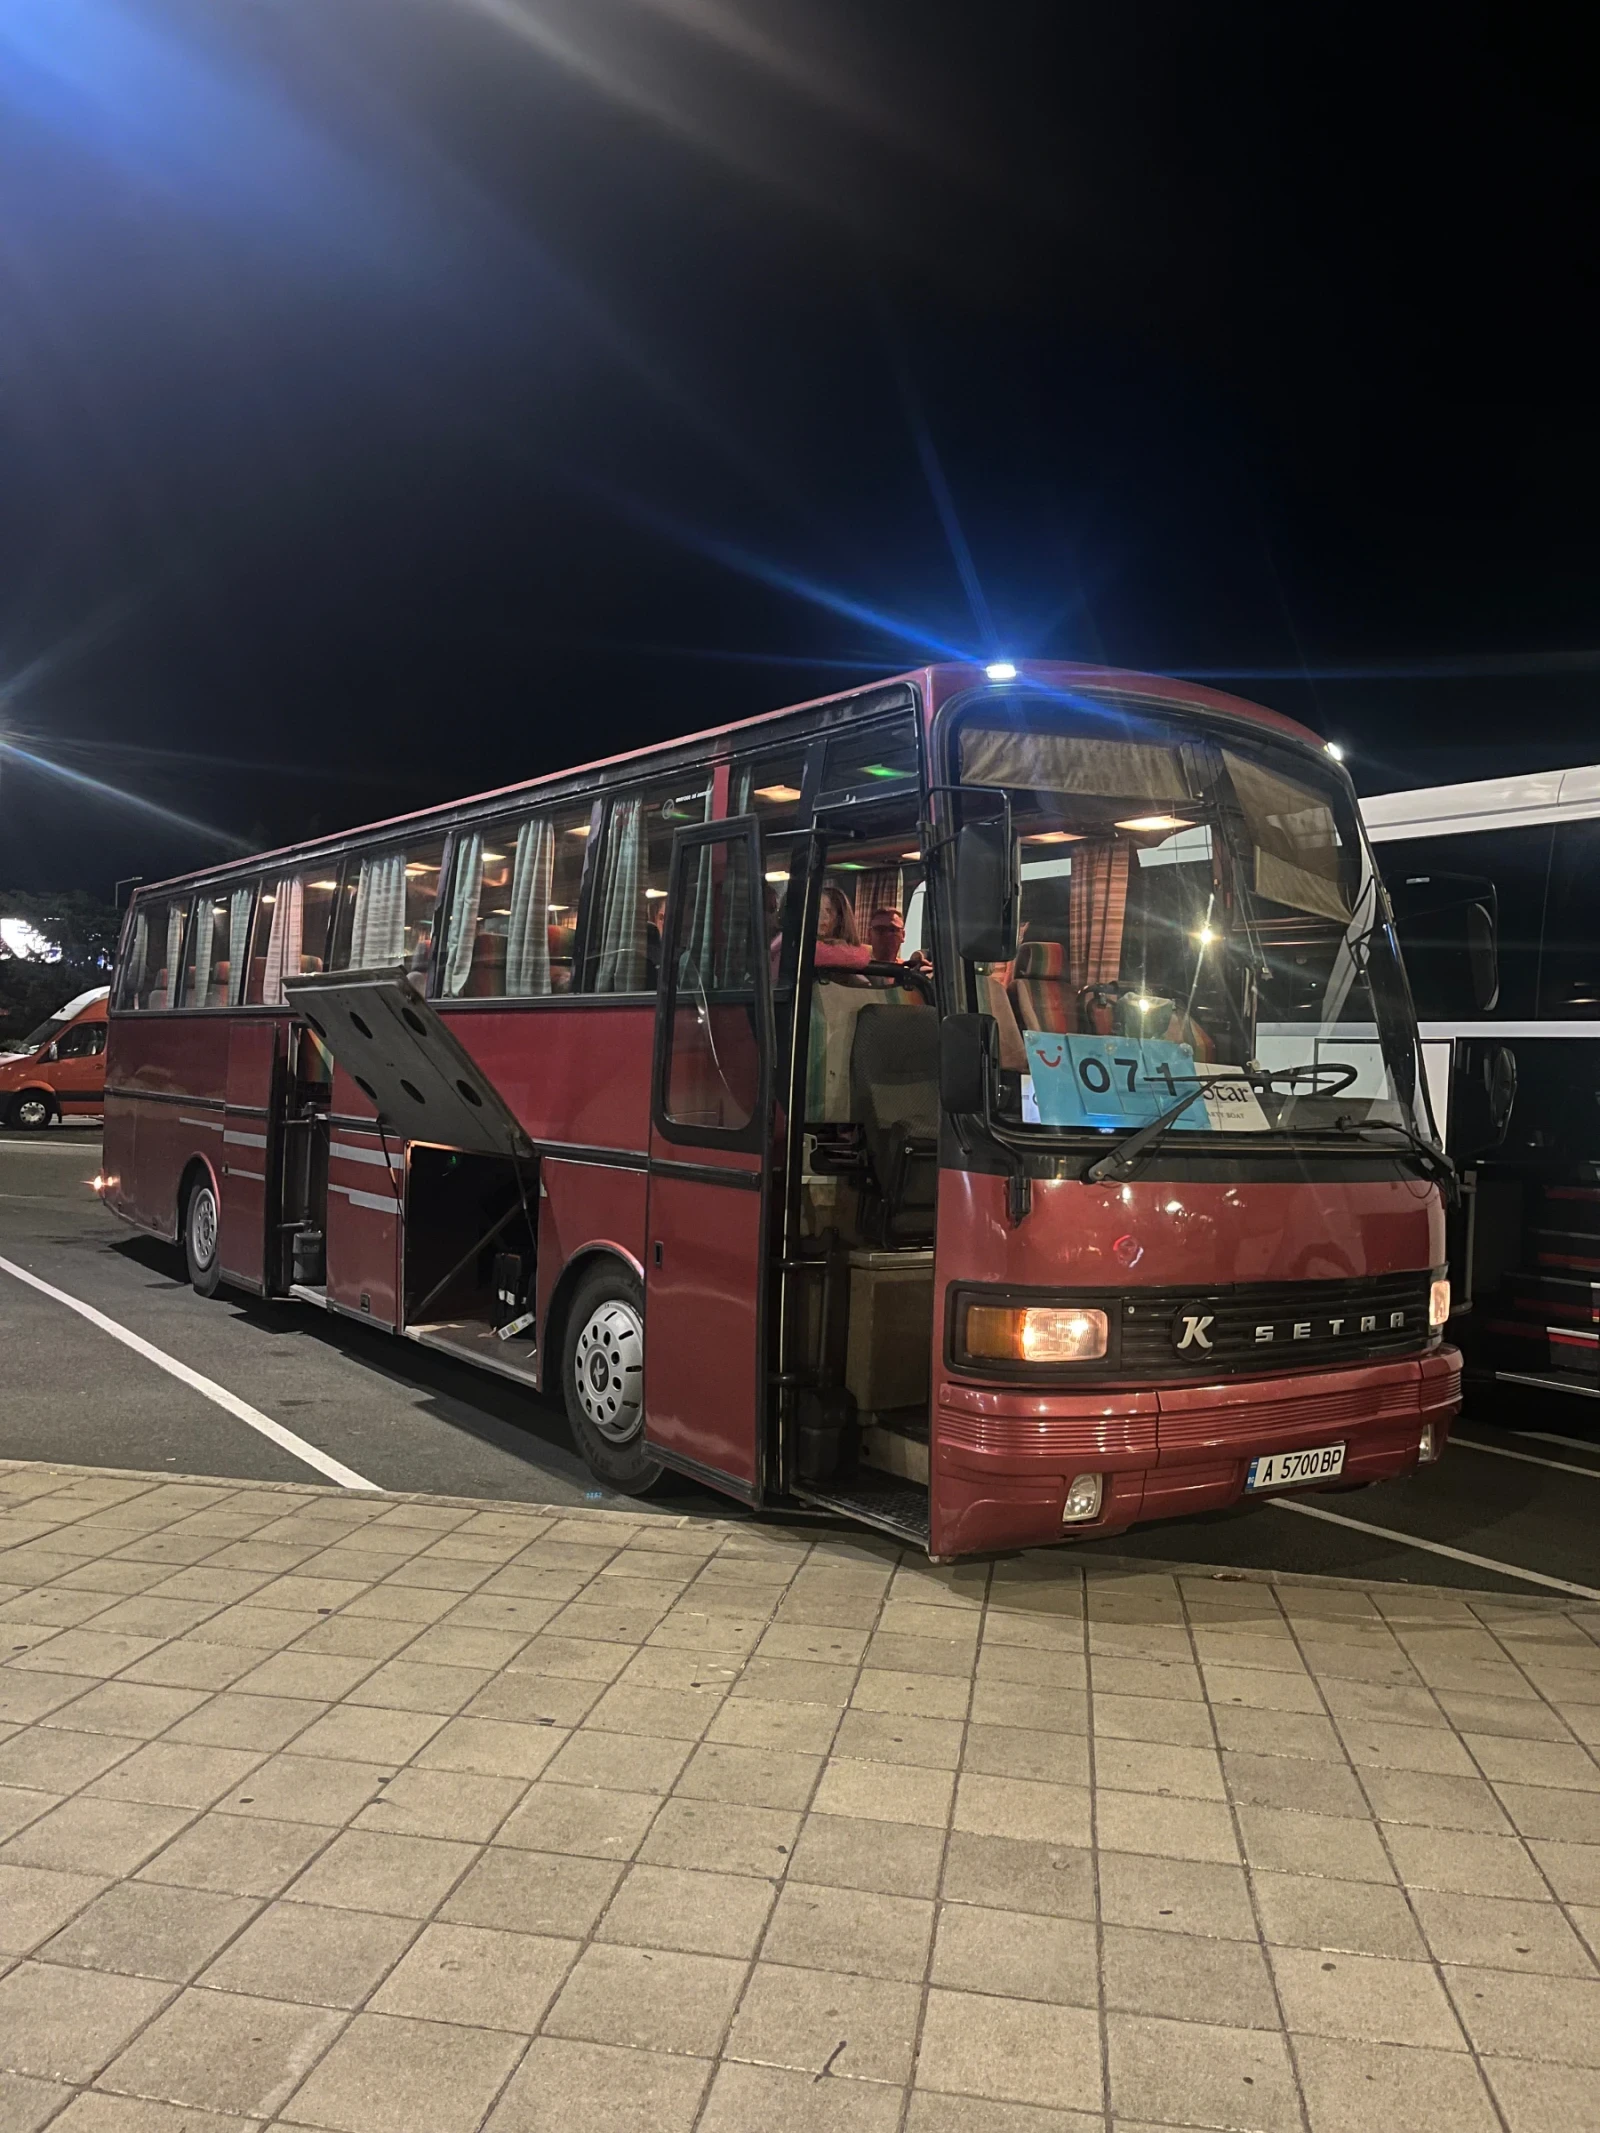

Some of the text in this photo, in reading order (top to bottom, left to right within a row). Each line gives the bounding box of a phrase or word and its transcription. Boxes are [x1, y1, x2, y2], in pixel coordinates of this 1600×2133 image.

[1079, 1057, 1177, 1096] 071
[1255, 1312, 1404, 1342] SETRA
[1262, 1459, 1273, 1483] A
